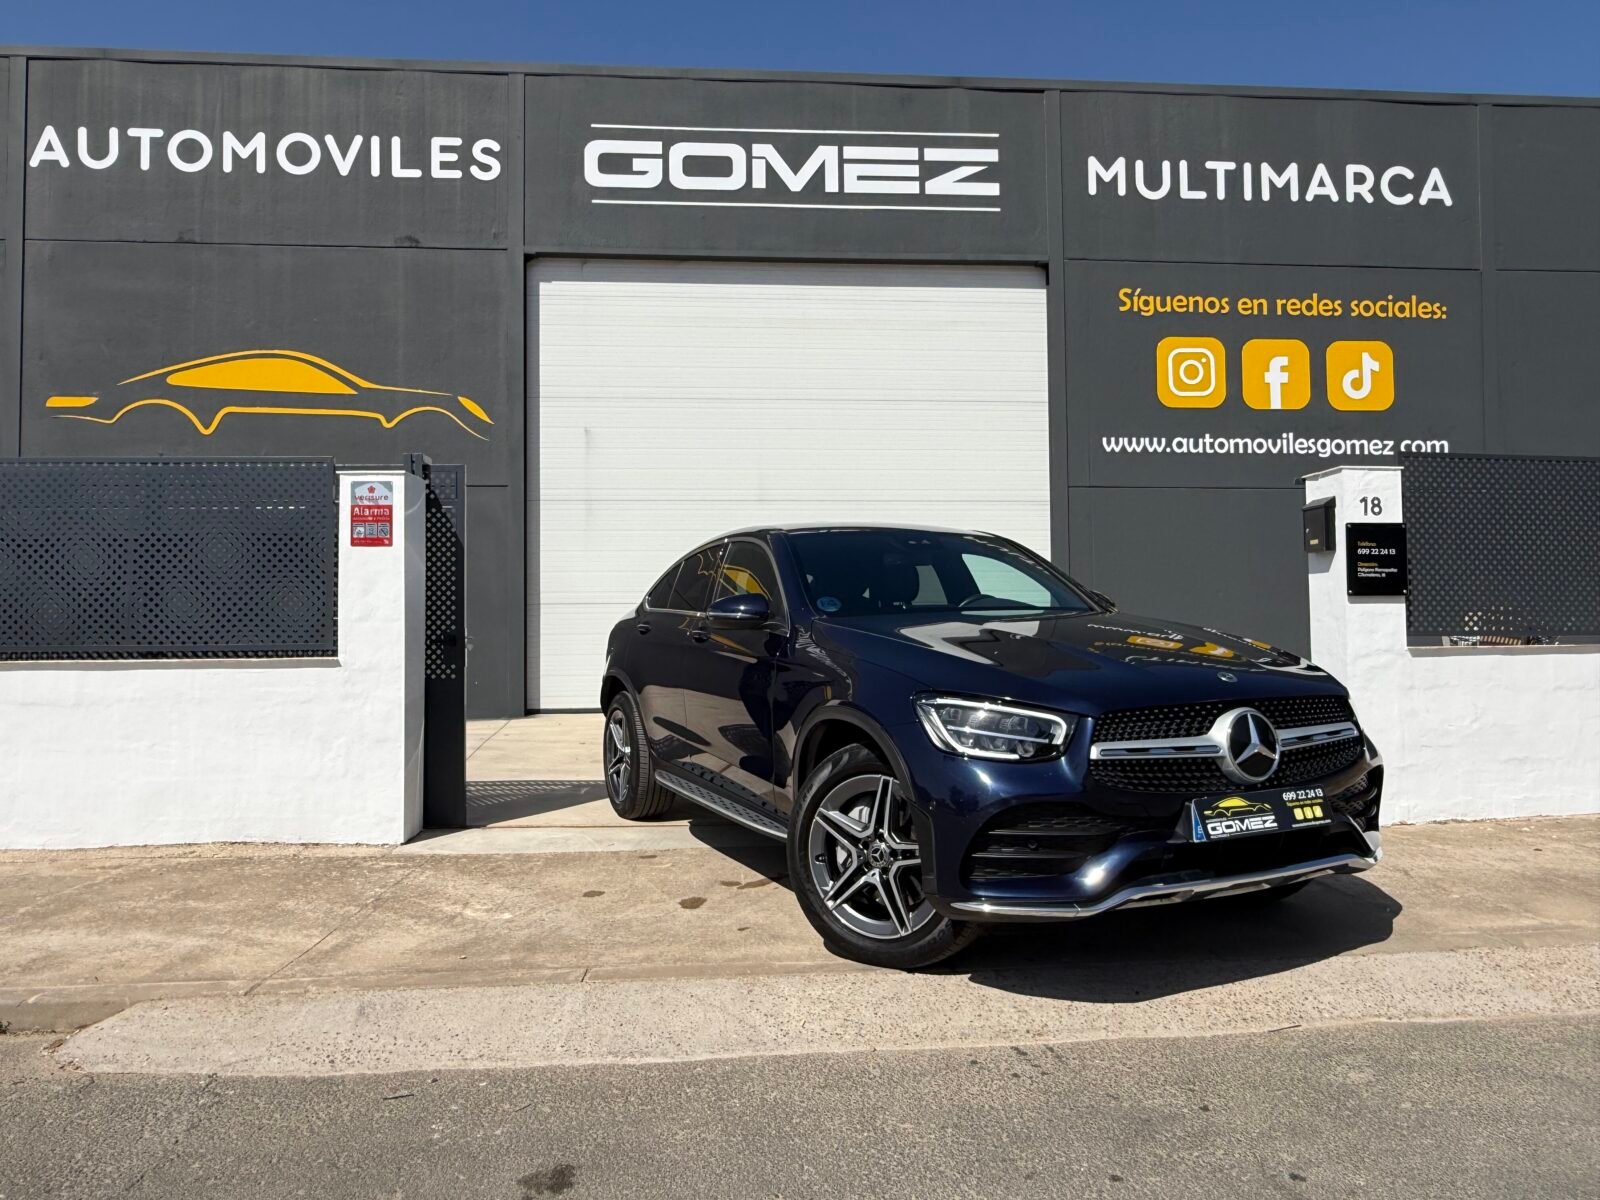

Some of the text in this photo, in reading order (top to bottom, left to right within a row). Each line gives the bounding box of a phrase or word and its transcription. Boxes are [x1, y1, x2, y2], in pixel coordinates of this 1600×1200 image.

[28, 124, 502, 181] AUTOMOVILES
[584, 139, 1001, 196] GOMEZ
[1087, 155, 1453, 207] MULTIMARCA
[1118, 287, 1447, 320] Síguenos en redes sociales:
[1102, 432, 1449, 457] www.automovilesgomezcom
[353, 507, 390, 516] Alarma
[1359, 496, 1383, 516] 18
[1282, 788, 1324, 801] 699 22 24 13
[1207, 815, 1278, 835] GOMEZ
